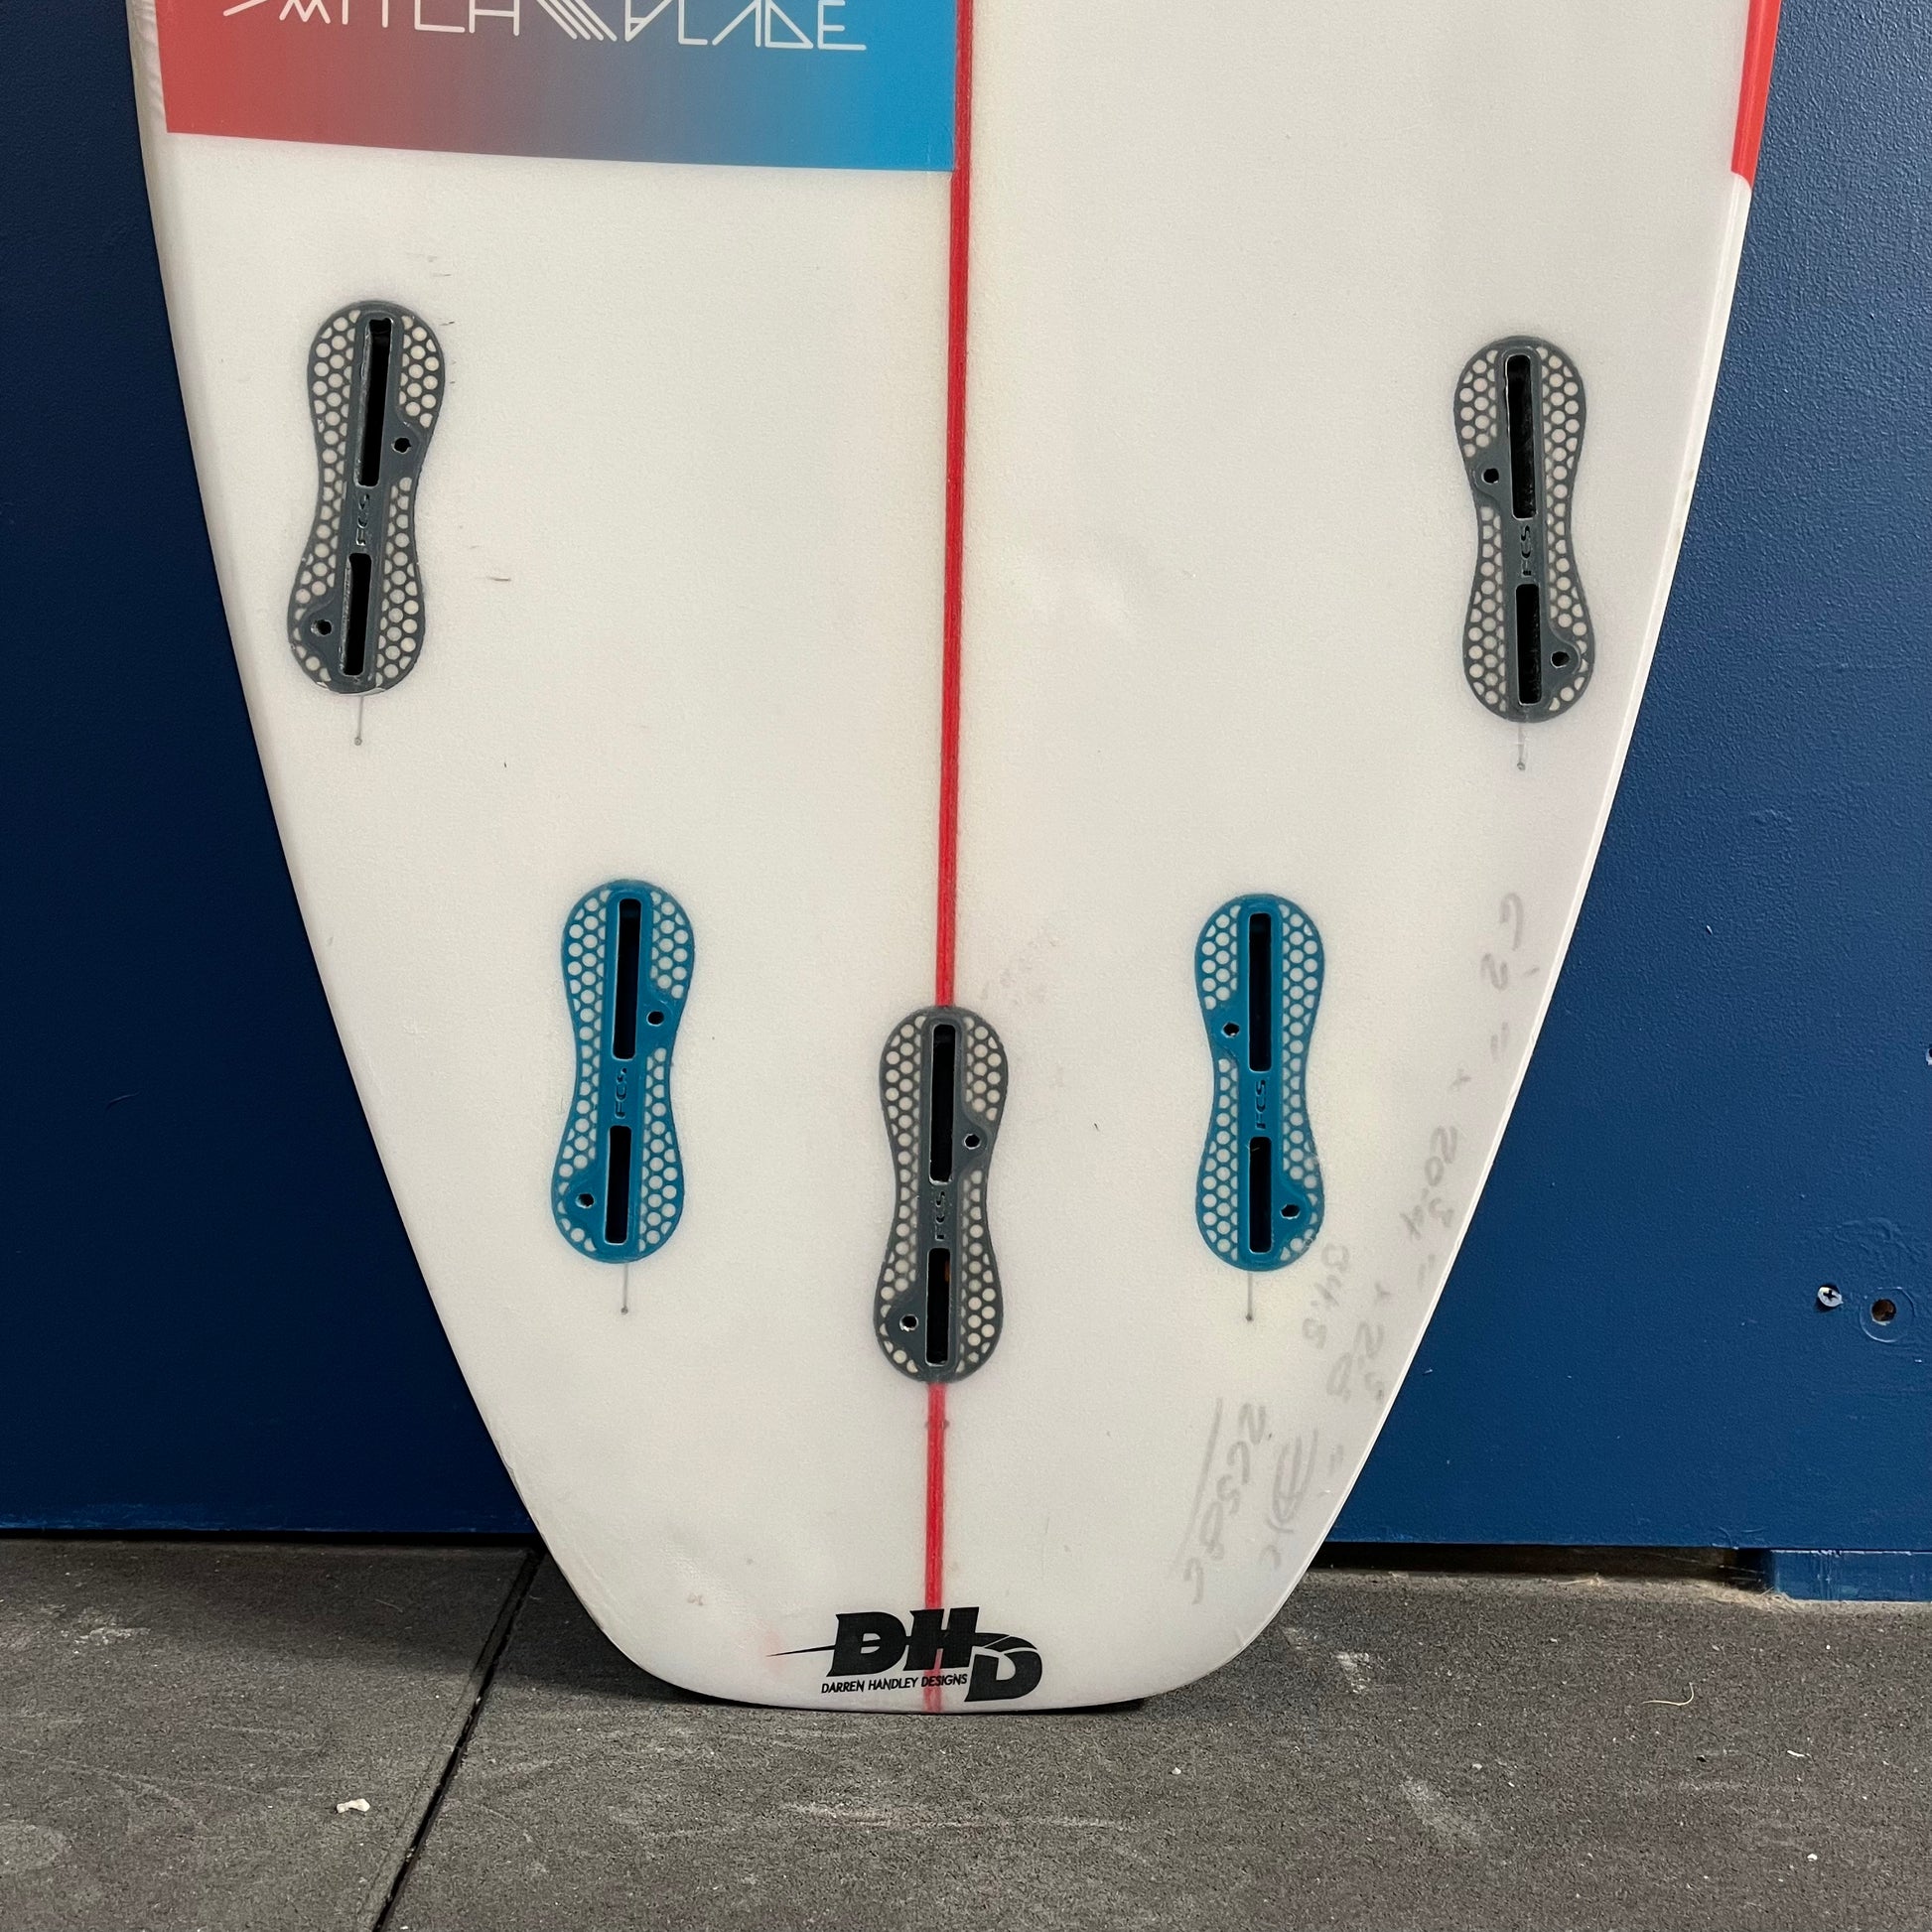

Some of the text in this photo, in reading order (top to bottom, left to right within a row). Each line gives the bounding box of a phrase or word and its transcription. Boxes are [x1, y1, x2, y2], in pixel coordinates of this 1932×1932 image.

[355, 492, 370, 547] FCS
[1519, 524, 1534, 577] FCS
[614, 1066, 628, 1120] FCS
[1253, 1079, 1268, 1131] FCS
[825, 1605, 1043, 1703] DHD
[820, 1672, 968, 1695] DARREN HANDLEY DESIGNS
